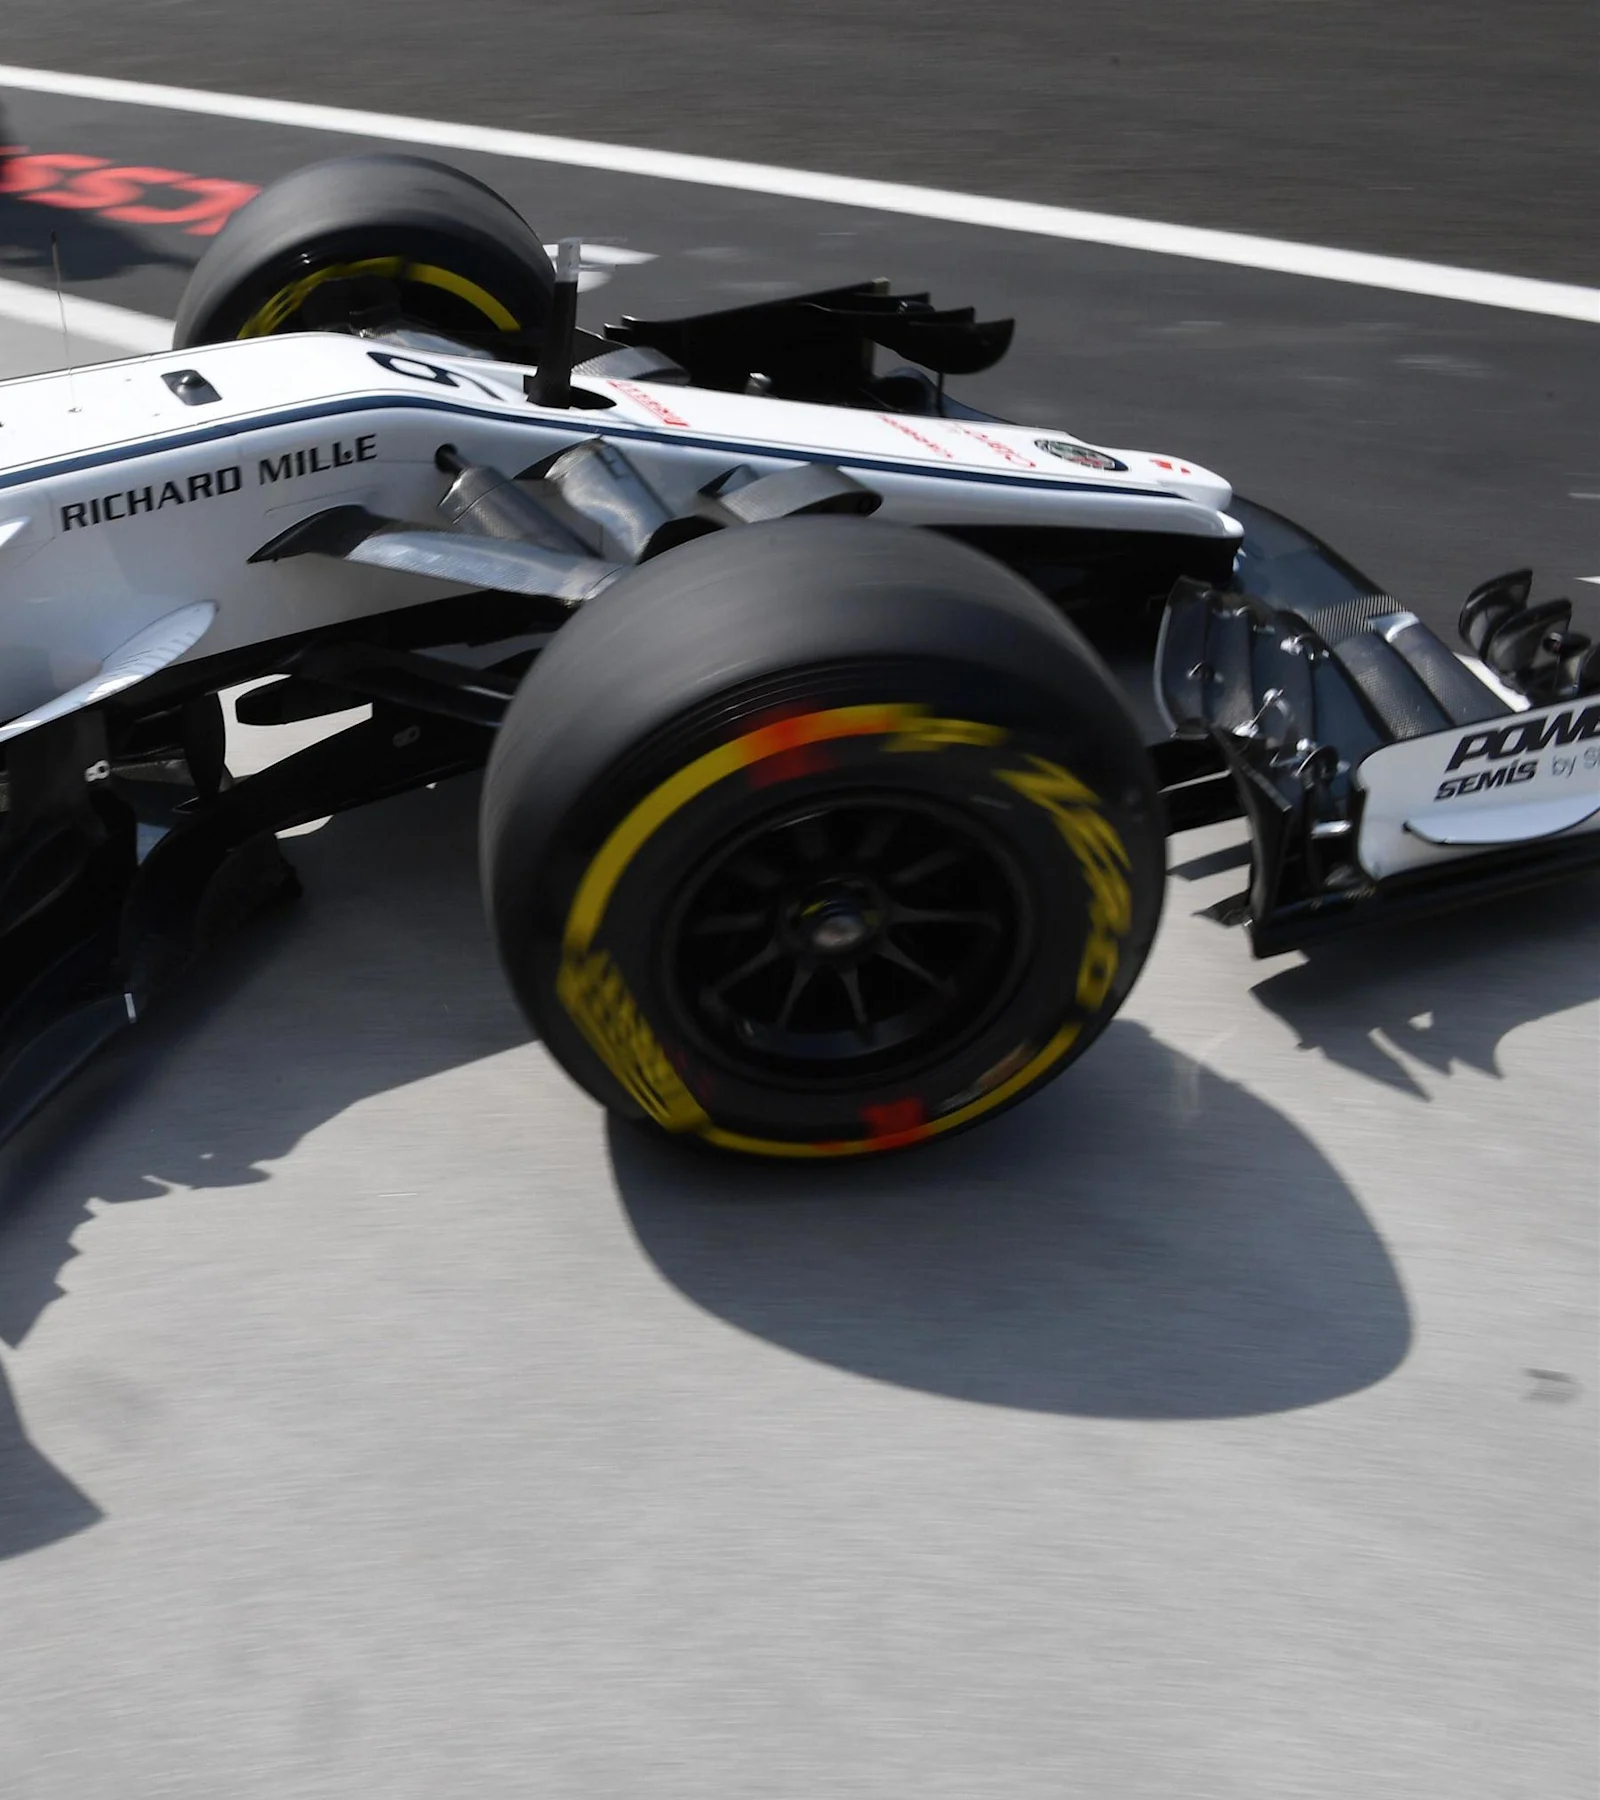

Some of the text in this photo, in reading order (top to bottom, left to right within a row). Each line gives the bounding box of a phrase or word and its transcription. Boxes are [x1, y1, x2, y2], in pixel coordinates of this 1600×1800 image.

[60, 433, 377, 532] RICHARD MILLE
[1551, 754, 1578, 778] by
